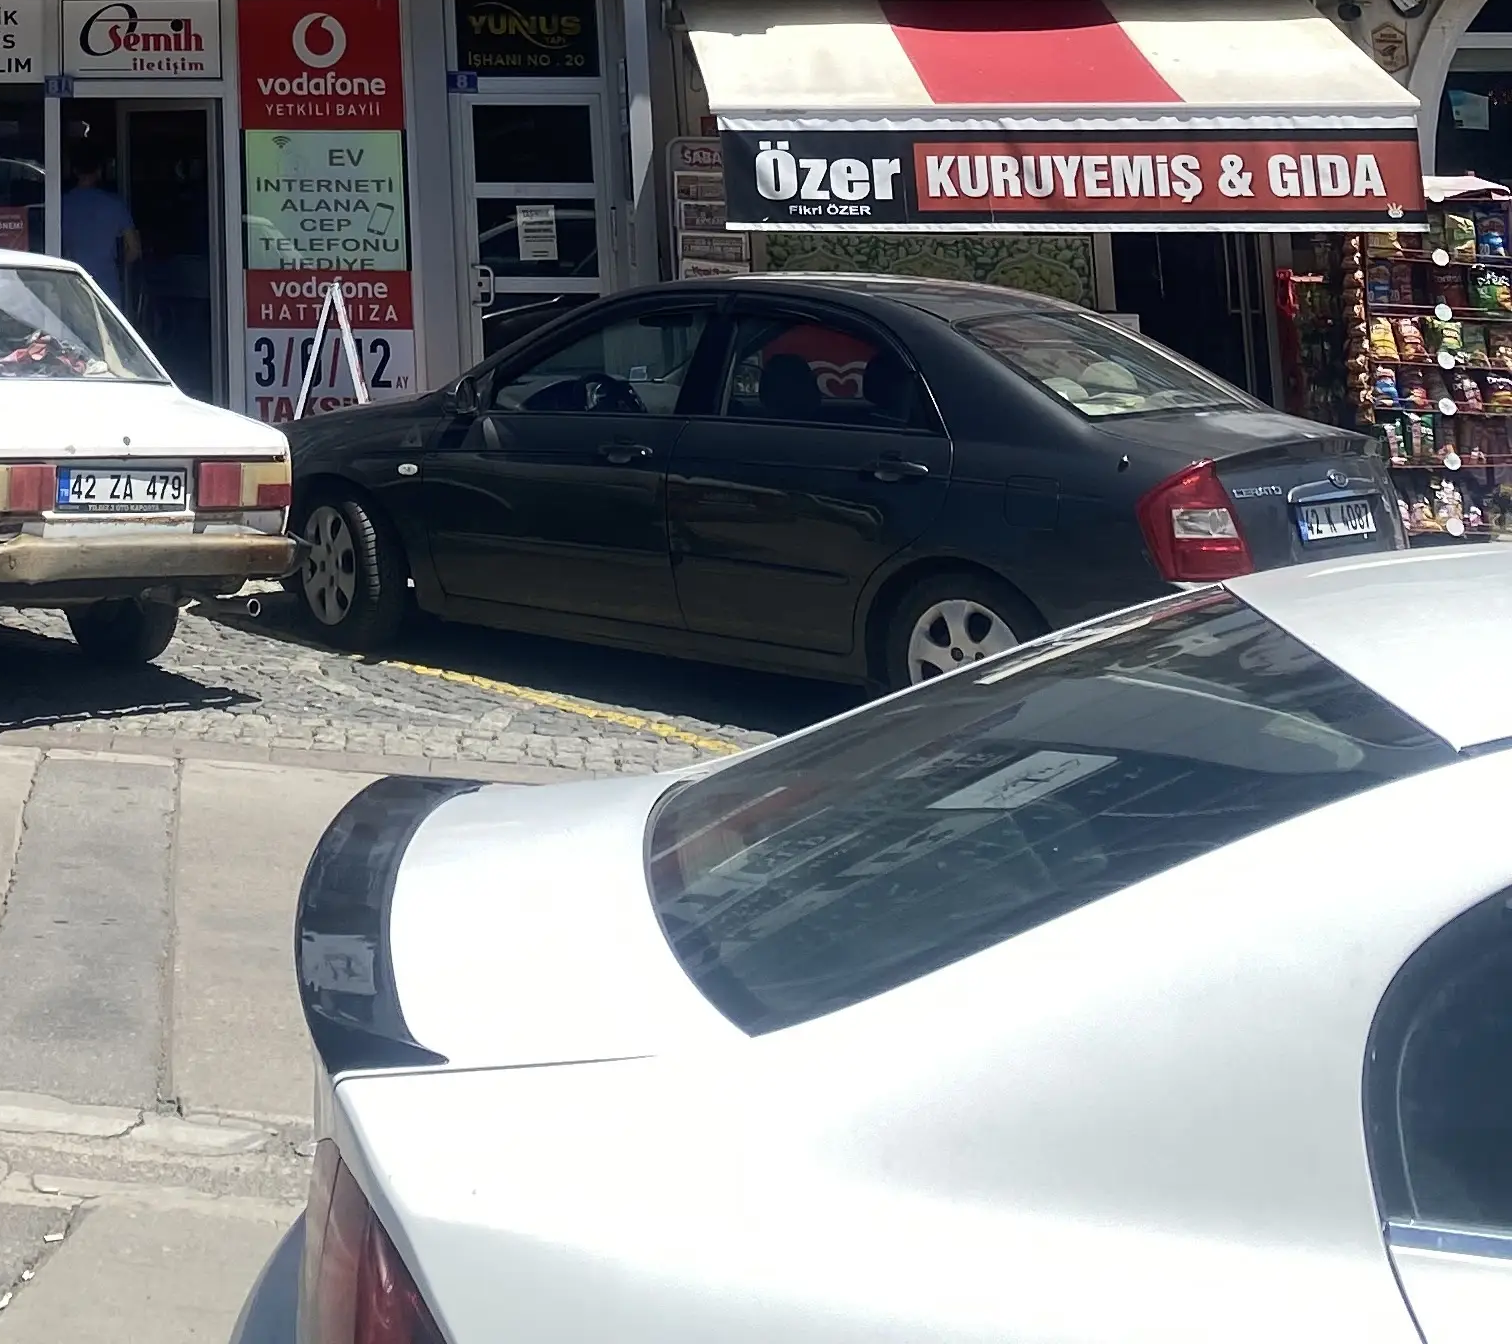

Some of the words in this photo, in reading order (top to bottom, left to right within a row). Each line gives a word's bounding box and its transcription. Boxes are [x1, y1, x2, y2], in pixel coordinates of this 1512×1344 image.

[91, 8, 205, 55] Semih
[468, 14, 582, 35] YUNUS
[132, 57, 205, 75] iletişim
[256, 71, 387, 96] vodafone
[456, 74, 469, 89] 8
[265, 101, 331, 116] YETKİLİ
[335, 101, 382, 116] BAYİİ
[327, 148, 365, 167] EV
[755, 140, 902, 201] Özer
[1217, 156, 1255, 198] &
[1266, 152, 1387, 198] GIDA
[255, 176, 394, 193] İNTERNETİ
[280, 198, 370, 212] ALANA
[826, 203, 872, 216] ÖZER
[299, 218, 352, 232] CEP
[258, 237, 401, 252] TELEFONU
[395, 376, 410, 390] AY
[71, 474, 97, 500] 42
[109, 474, 134, 500] ZA
[146, 475, 183, 500] 479
[1304, 508, 1324, 535] 42
